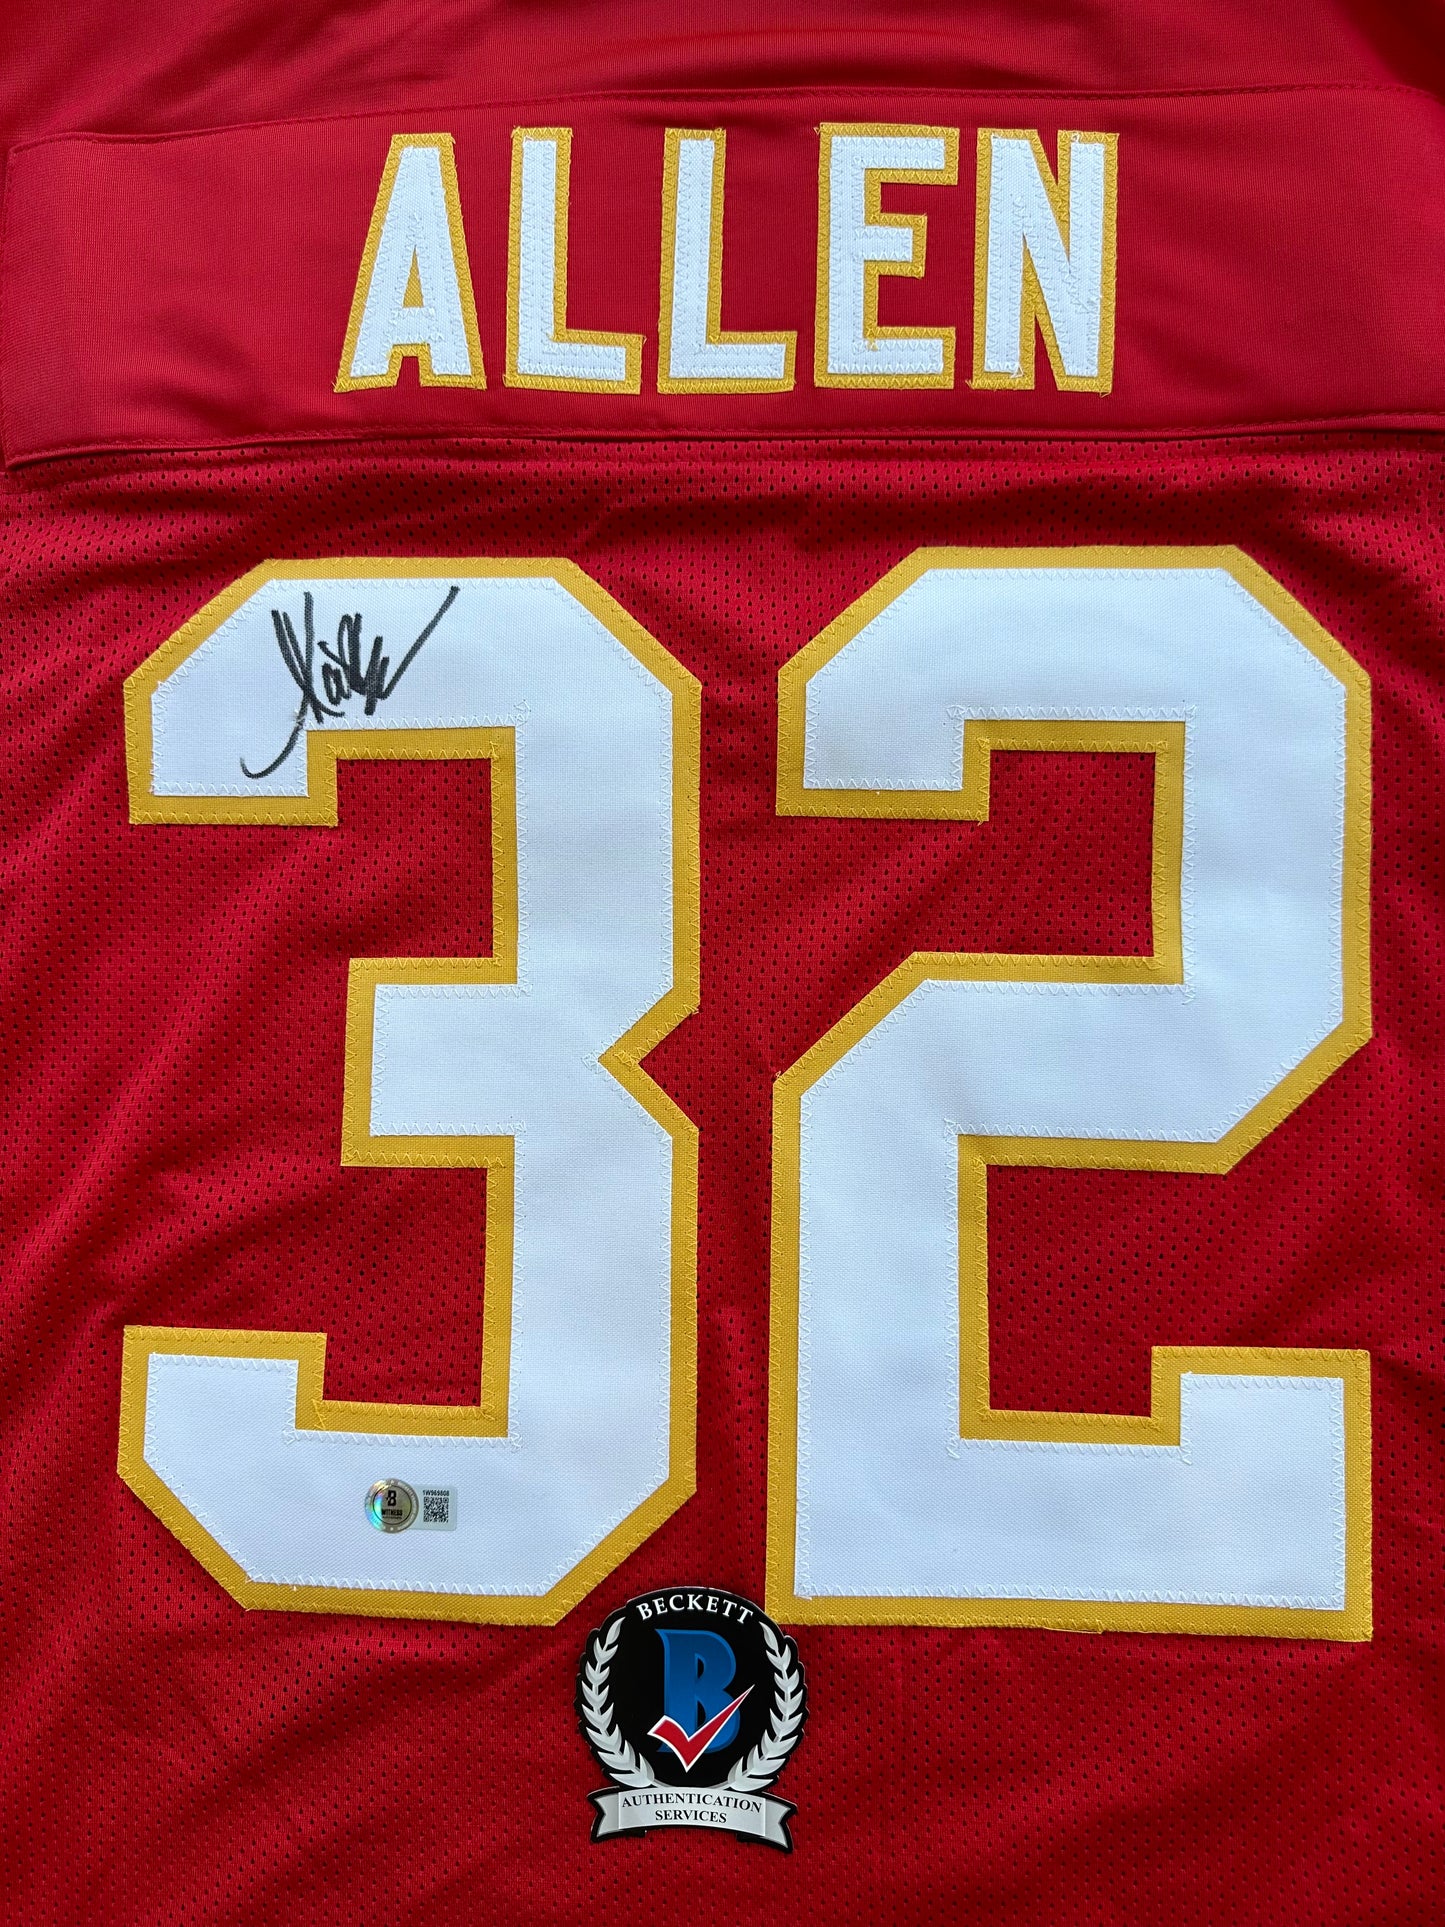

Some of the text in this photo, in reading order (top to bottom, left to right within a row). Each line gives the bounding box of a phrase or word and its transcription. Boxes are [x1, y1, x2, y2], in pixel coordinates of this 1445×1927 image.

[334, 121, 1120, 396] ALLEN
[117, 545, 1373, 1643] 32
[636, 1593, 754, 1624] BECKETT
[621, 1792, 762, 1814] AUTHENTICATION
[655, 1809, 727, 1824] SERVICES
